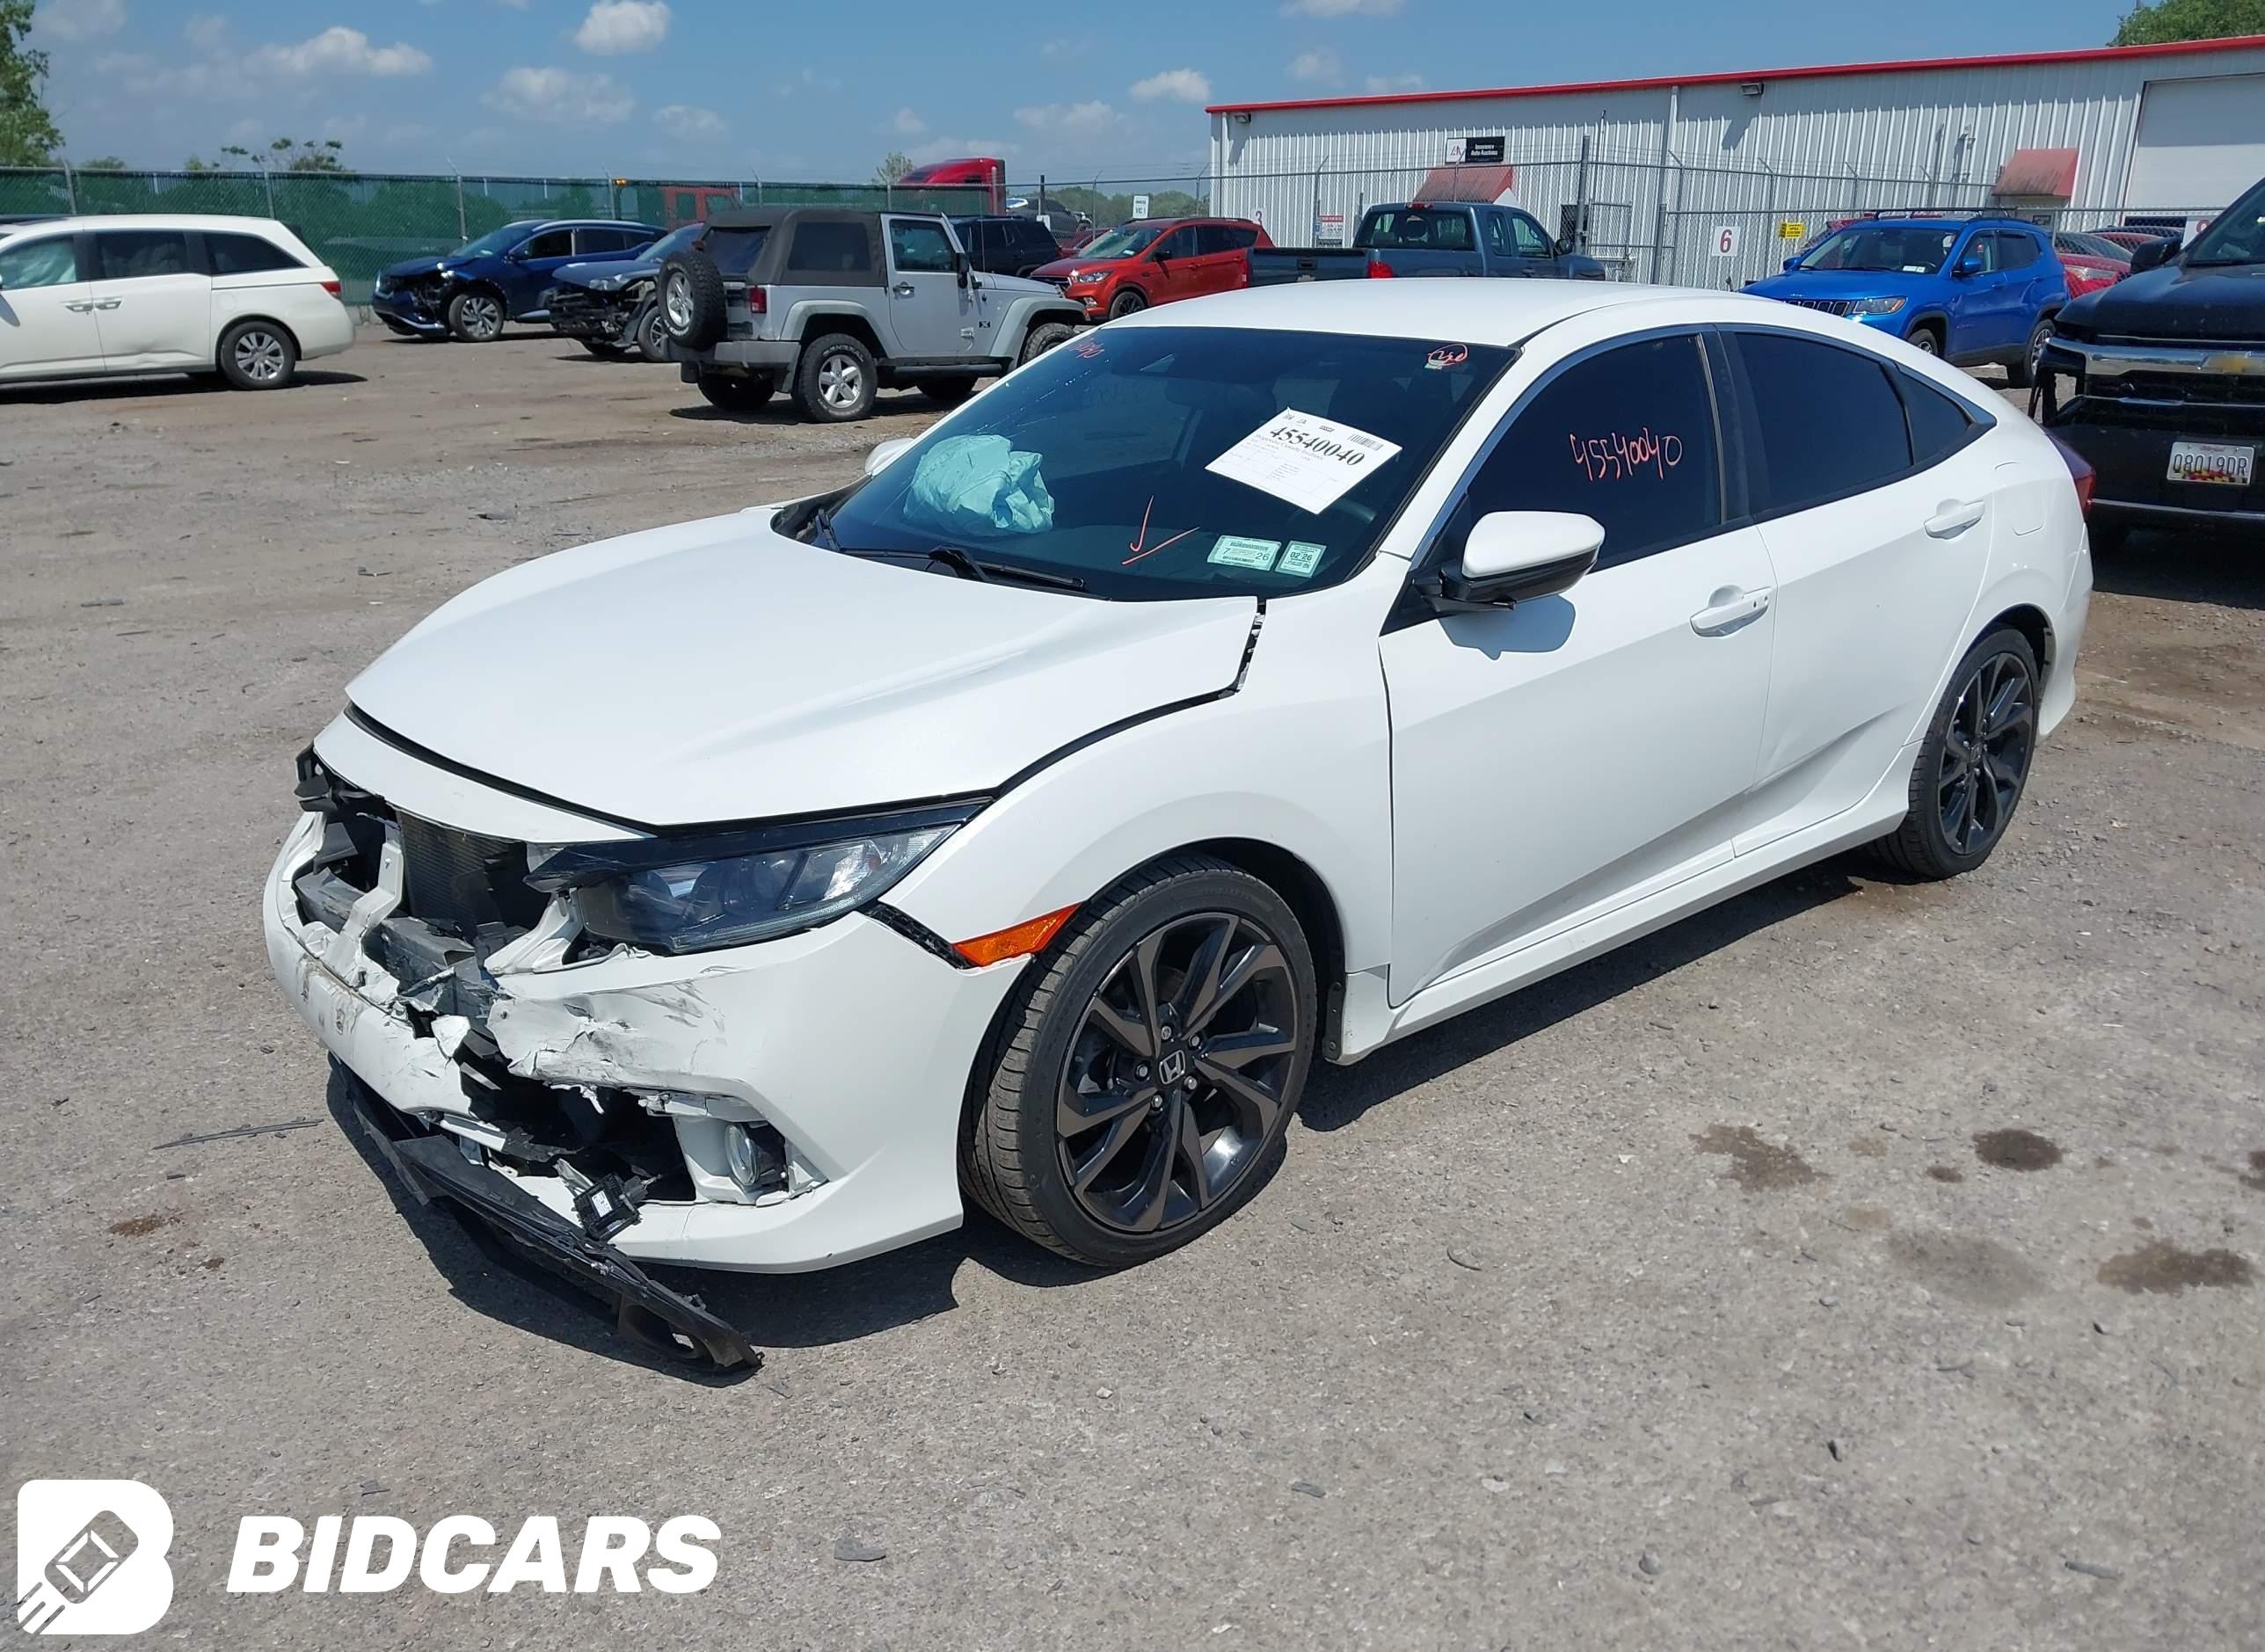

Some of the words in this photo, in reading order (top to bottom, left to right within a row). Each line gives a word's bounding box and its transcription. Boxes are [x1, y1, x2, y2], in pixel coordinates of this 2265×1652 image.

[1720, 229, 1732, 253] 6
[1270, 426, 1365, 466] 45540040
[1569, 427, 1683, 481] 45540040
[1255, 552, 1271, 561] 26
